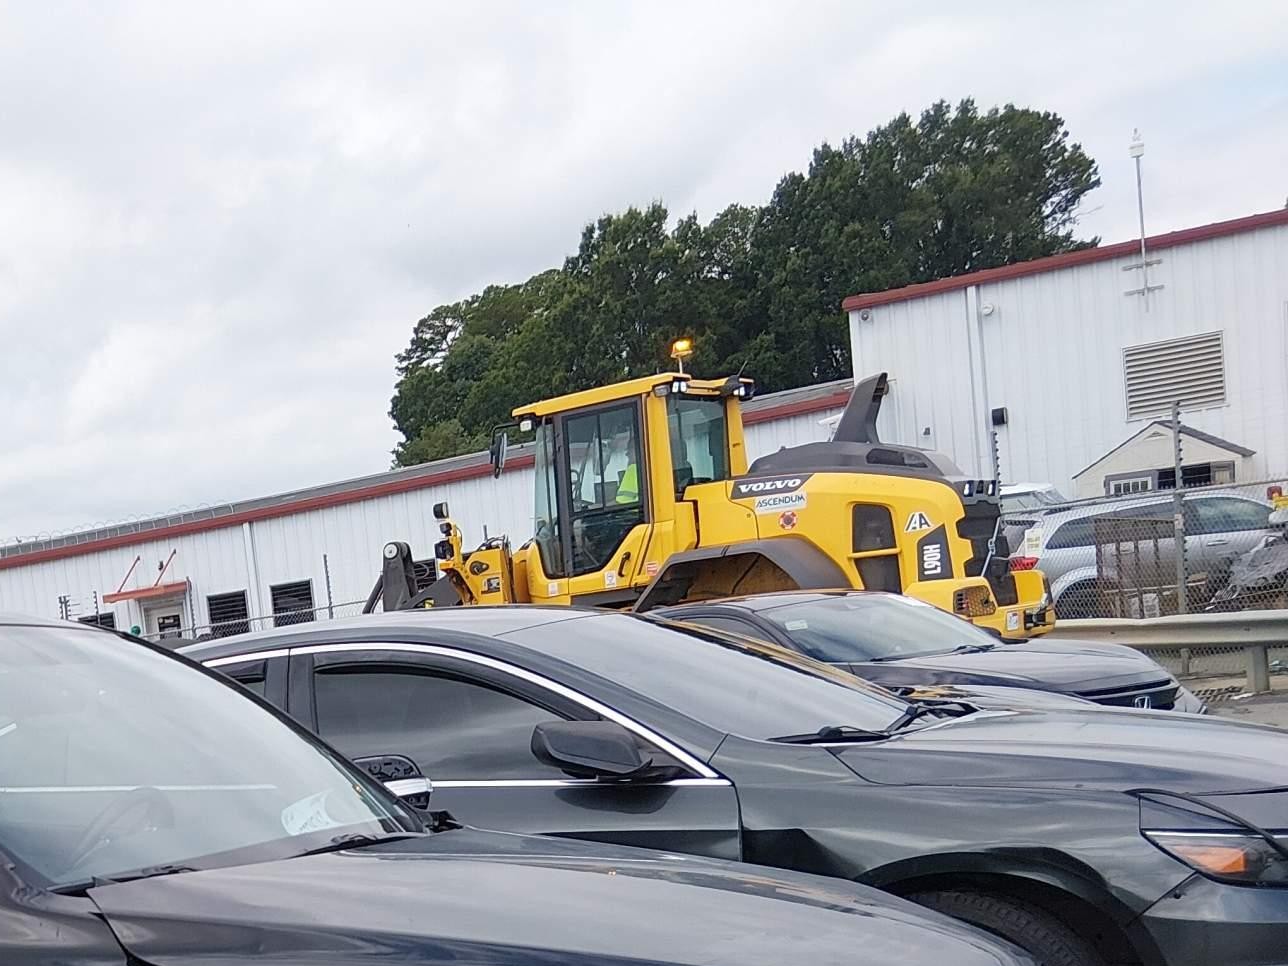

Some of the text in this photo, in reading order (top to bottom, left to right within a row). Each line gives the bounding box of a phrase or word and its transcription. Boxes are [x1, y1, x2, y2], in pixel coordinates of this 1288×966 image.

[738, 478, 801, 493] VOLVO
[756, 494, 805, 508] ASCENDUM
[923, 543, 941, 575] L90H
